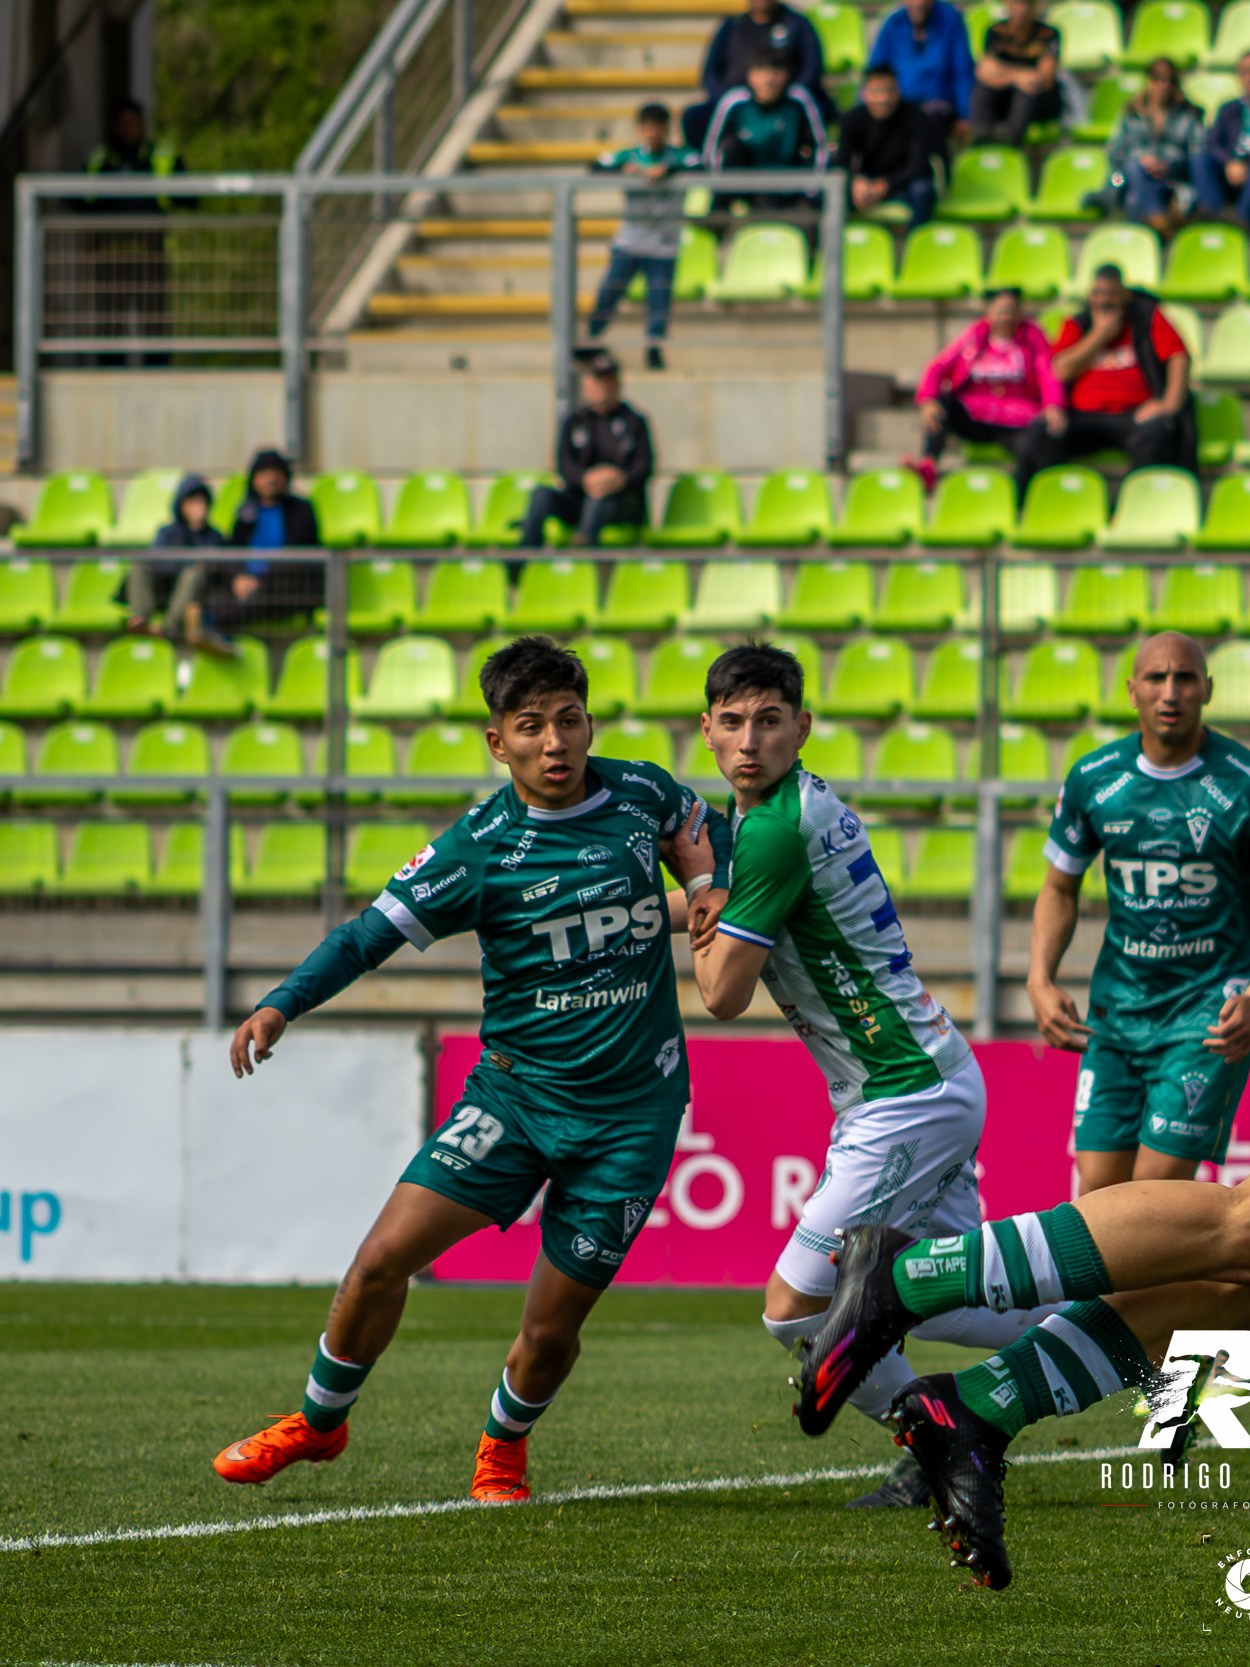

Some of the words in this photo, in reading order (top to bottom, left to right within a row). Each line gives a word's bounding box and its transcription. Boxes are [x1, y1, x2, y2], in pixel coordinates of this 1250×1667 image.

[1095, 771, 1135, 805] Biozen
[1200, 774, 1233, 811] Biozen
[501, 829, 538, 871] Biozen
[1109, 859, 1219, 897] TPS
[531, 894, 663, 963] TPS
[1123, 935, 1215, 959] Latamwin
[535, 979, 648, 1012] Latamwin
[436, 1105, 504, 1162] 23
[936, 1256, 967, 1275] TAPE
